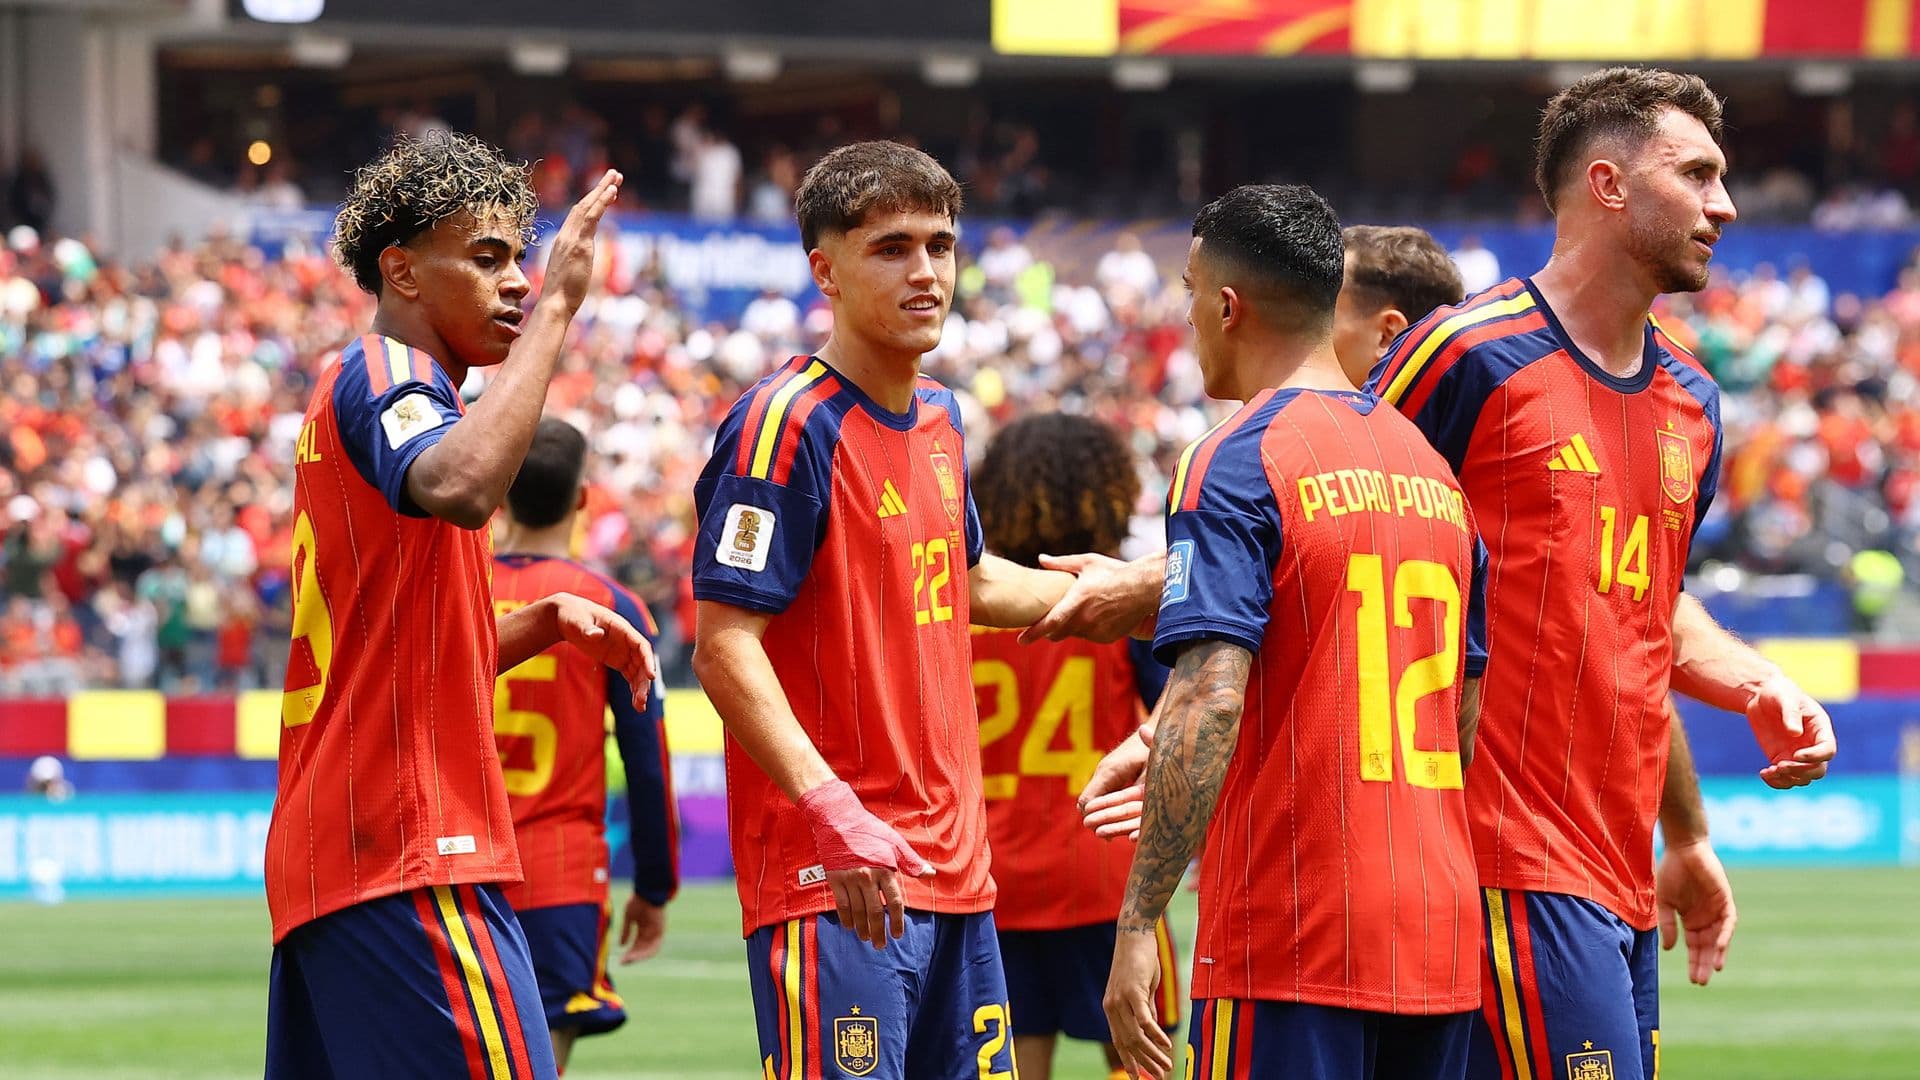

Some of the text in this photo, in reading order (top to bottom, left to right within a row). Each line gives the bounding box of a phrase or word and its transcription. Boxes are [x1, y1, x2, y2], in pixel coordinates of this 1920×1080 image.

[295, 420, 322, 465] AL
[1297, 468, 1467, 532] PEDRO PORRO
[729, 555, 752, 565] 2026
[912, 538, 953, 625] 22
[1597, 505, 1650, 602] 14
[1346, 553, 1465, 790] 12
[973, 656, 1105, 798] 24
